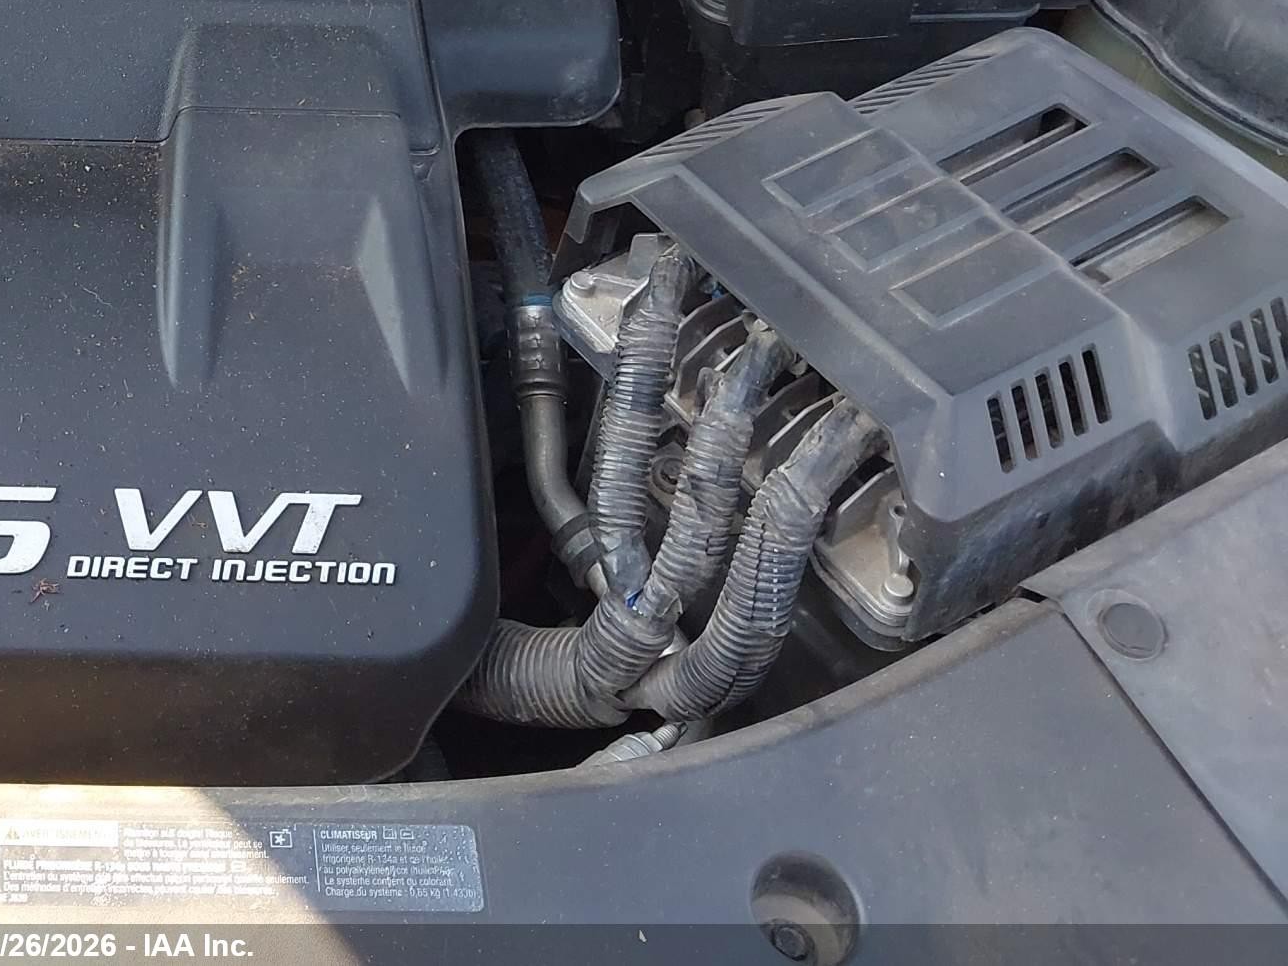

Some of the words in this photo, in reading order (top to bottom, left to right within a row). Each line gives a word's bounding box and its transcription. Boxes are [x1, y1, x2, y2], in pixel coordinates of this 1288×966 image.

[113, 488, 363, 555] VVT
[67, 555, 198, 581] DIRECT
[211, 557, 398, 586] INJECTION
[233, 840, 251, 851] peut
[320, 830, 377, 840] CLIMATISEUR
